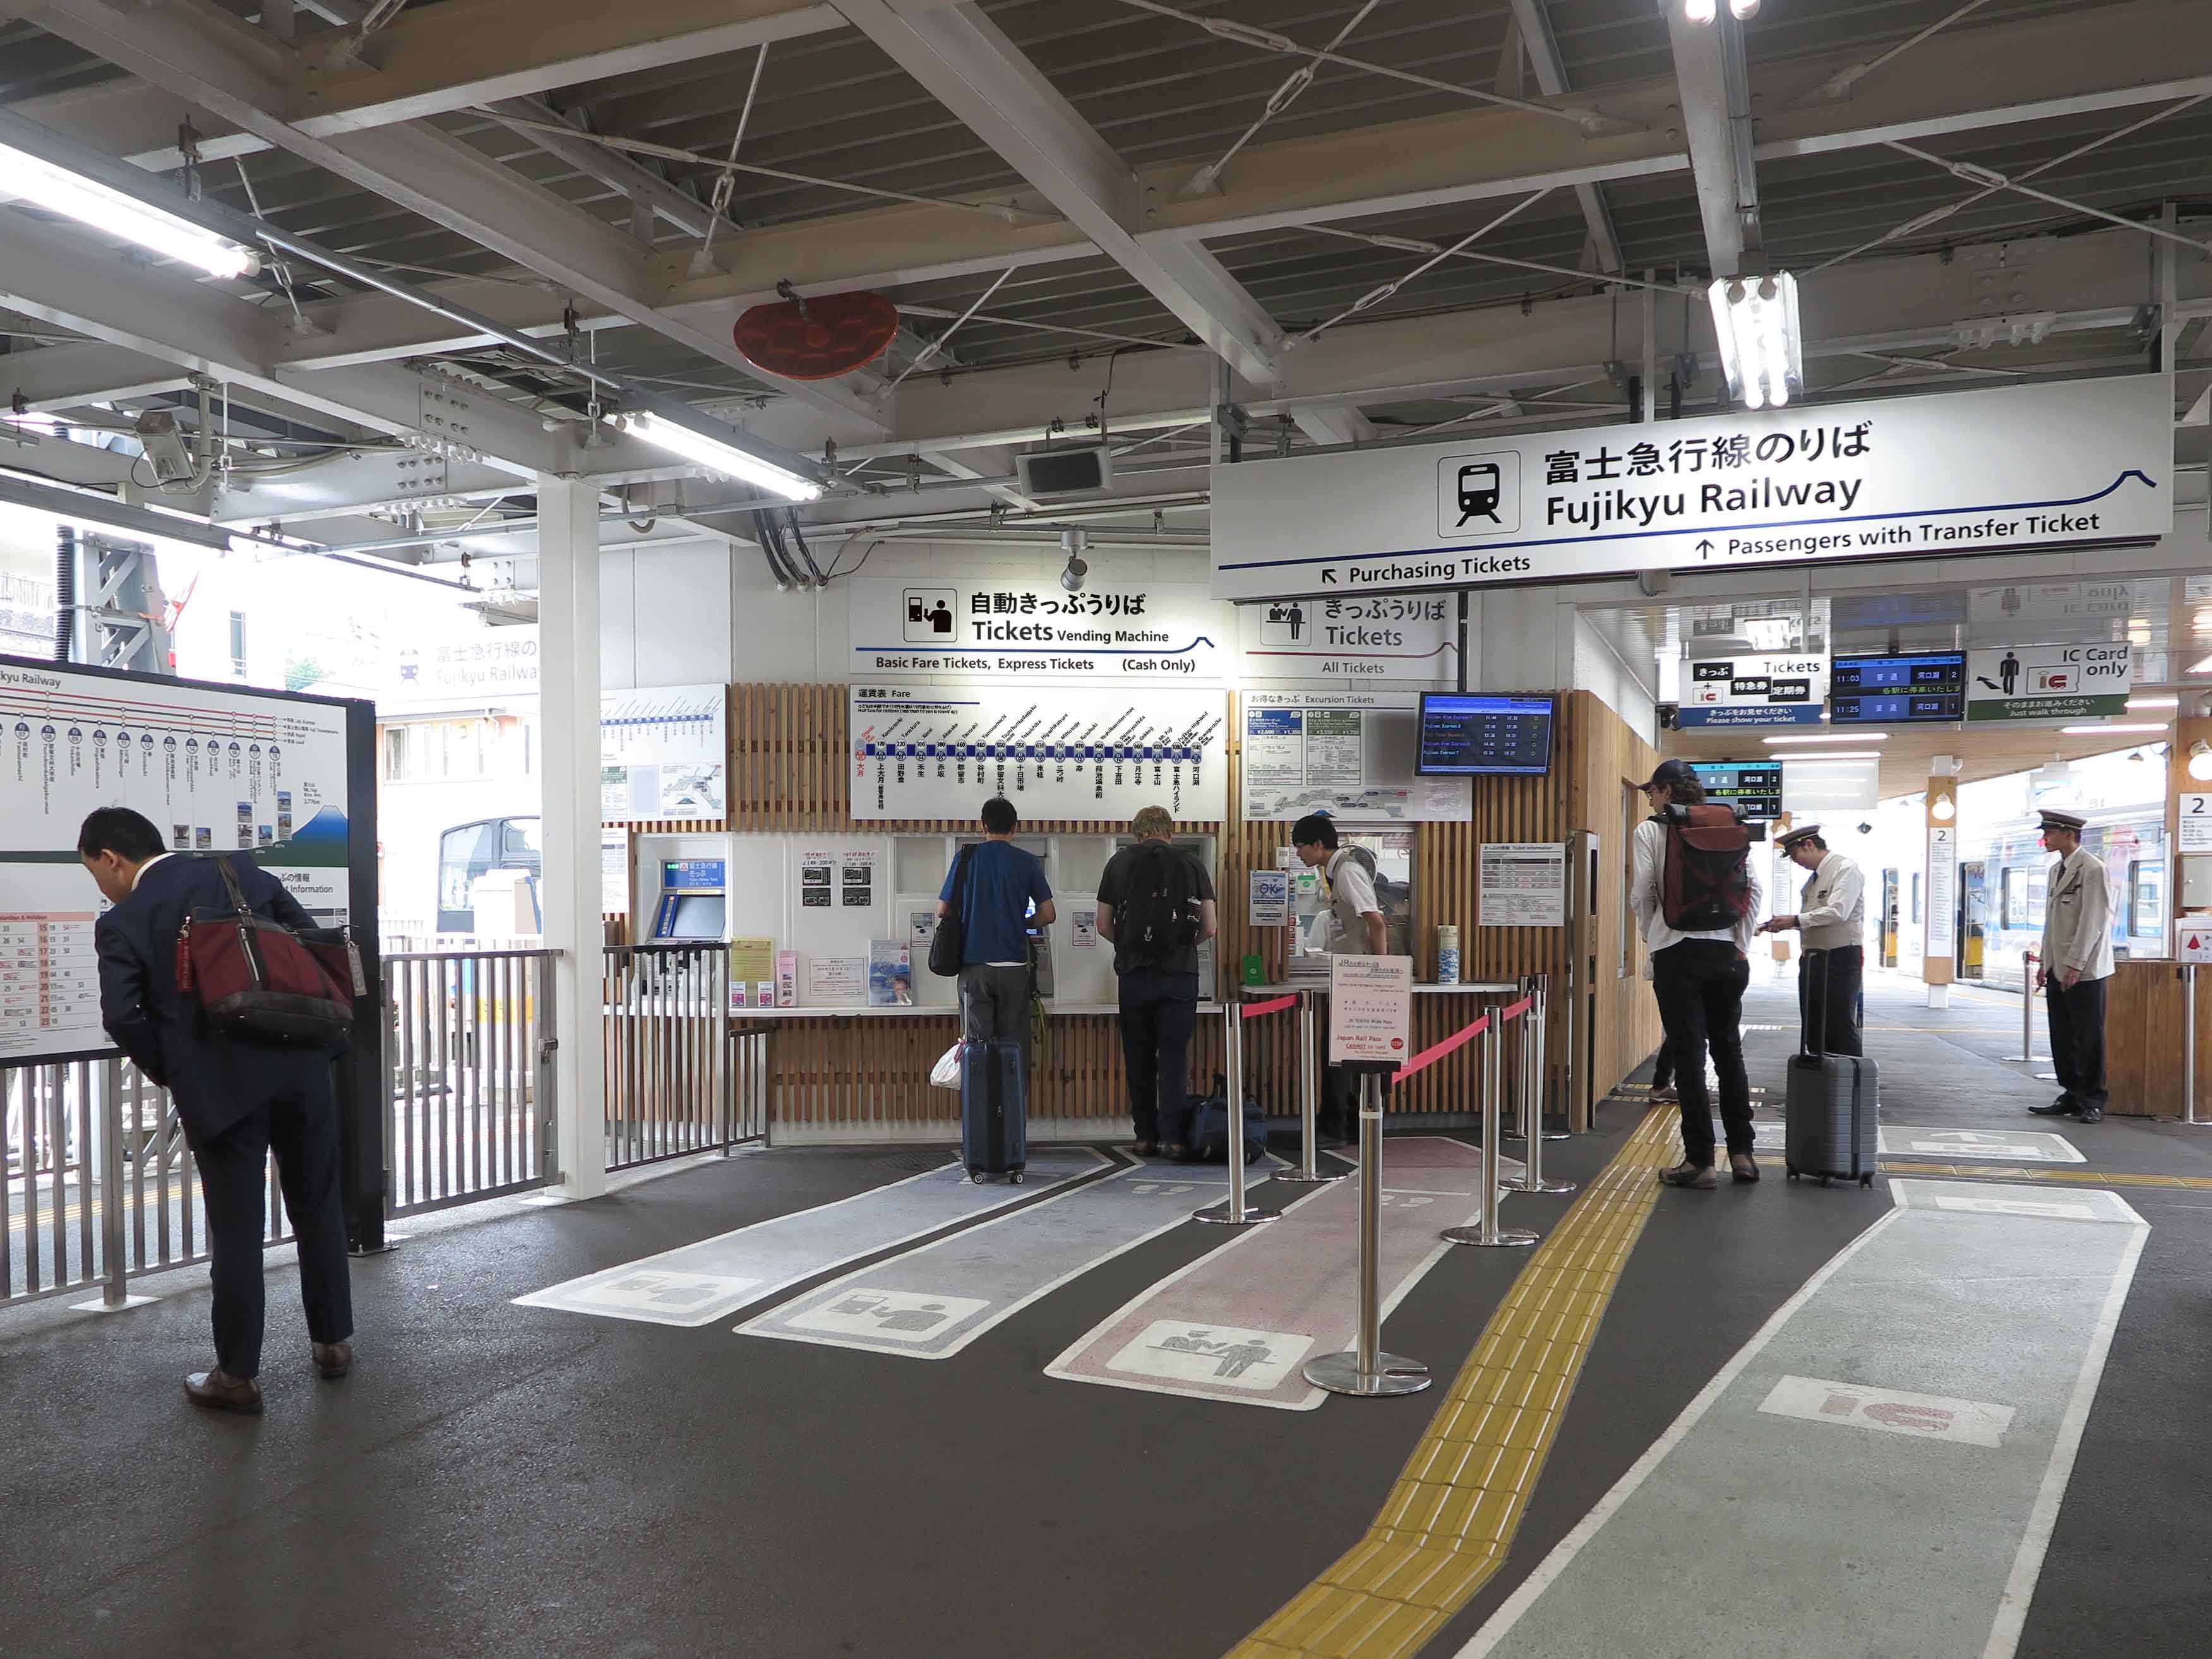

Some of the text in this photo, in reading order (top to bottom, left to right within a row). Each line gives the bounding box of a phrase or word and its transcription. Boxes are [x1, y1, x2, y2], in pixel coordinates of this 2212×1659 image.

[1545, 420, 1873, 485] 富士急行線のりば
[1548, 476, 1862, 529] Fujikyu Railway
[1728, 513, 2100, 556] Passengers with Transfer Ticket
[1349, 554, 1531, 583] Purchasing Tickets
[971, 592, 1146, 616] 自動きっぷうりば
[1325, 598, 1445, 621] きっぷうりば
[972, 621, 1169, 644] Tickets Vending Machine
[1325, 626, 1403, 647] Tickets
[437, 640, 537, 663] 富士急行線の
[2063, 646, 2127, 662] IC Card
[876, 657, 1196, 674] Basic Fare Tickets, Express Tickets (Cash Only)
[1322, 662, 1384, 674] All Tickets
[1699, 666, 1728, 677] きっぷ
[1764, 661, 1820, 674] Tickets
[2086, 662, 2127, 677] only
[21, 673, 61, 689] Railway
[1734, 681, 1767, 691] 特急券
[858, 689, 887, 698] 運賃表
[1251, 695, 1300, 703] お得なきっぷ
[1773, 686, 1805, 696] 定期券
[2003, 698, 2096, 708] そのままお進みください
[1710, 708, 1792, 717] きっぷをお見せください
[2010, 708, 2027, 717] Just
[2051, 706, 2086, 715] through
[981, 714, 1007, 739] Yamuramachi
[1001, 705, 1037, 739] Tsurubunkadaigaku
[1021, 720, 1041, 739] Tokaichiba
[1042, 713, 1068, 740] Higashikatsura
[1120, 715, 1145, 740] Shimoyoshida
[942, 723, 959, 739] Akasaka
[962, 722, 978, 739] Tsurushi
[1061, 721, 1080, 740] Mitsutoge
[1080, 722, 1098, 740] Kotobuki
[857, 763, 864, 777] 大月
[917, 763, 924, 777] 禾生
[937, 763, 945, 777] 赤坂
[1036, 765, 1044, 778] 東桂
[2192, 797, 2205, 814] 2
[1938, 830, 1946, 841] 2
[290, 884, 333, 893] Information
